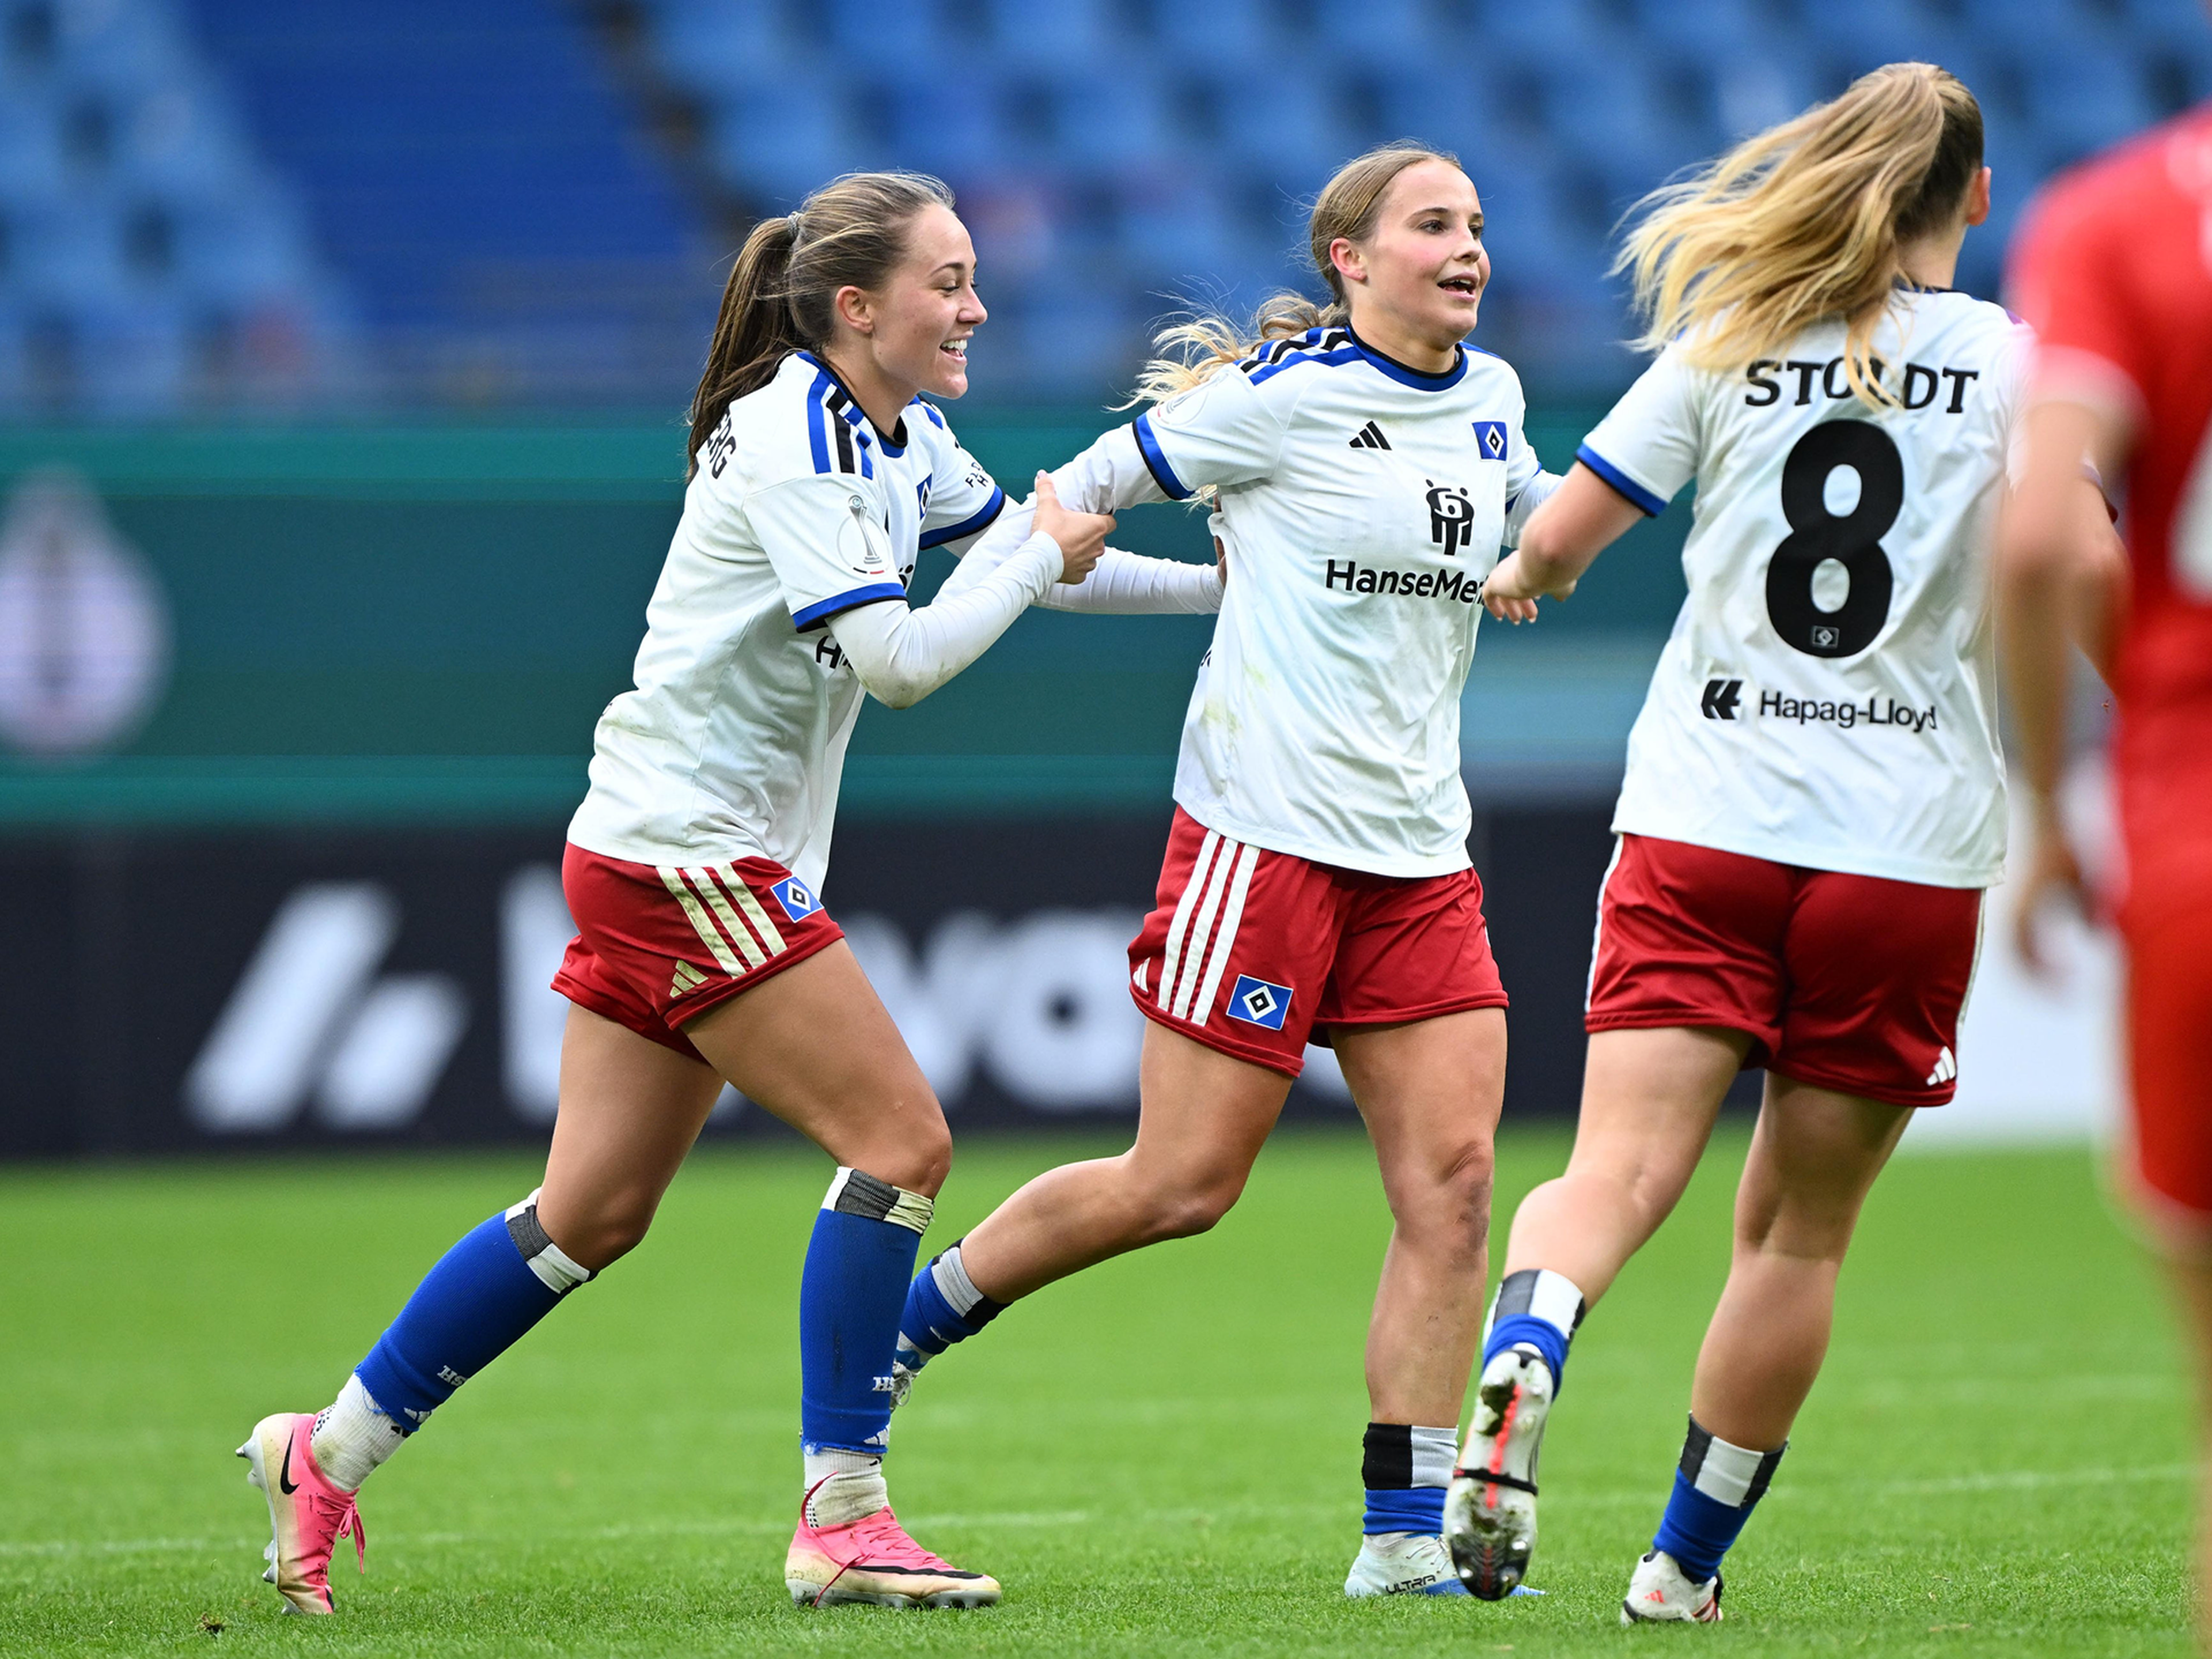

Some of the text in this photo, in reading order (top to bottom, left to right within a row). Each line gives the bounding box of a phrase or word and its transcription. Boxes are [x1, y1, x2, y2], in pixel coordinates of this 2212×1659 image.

[1766, 419, 1904, 658] 8
[1325, 559, 1489, 606] HanseMe
[1385, 1574, 1437, 1594] ULTRA
